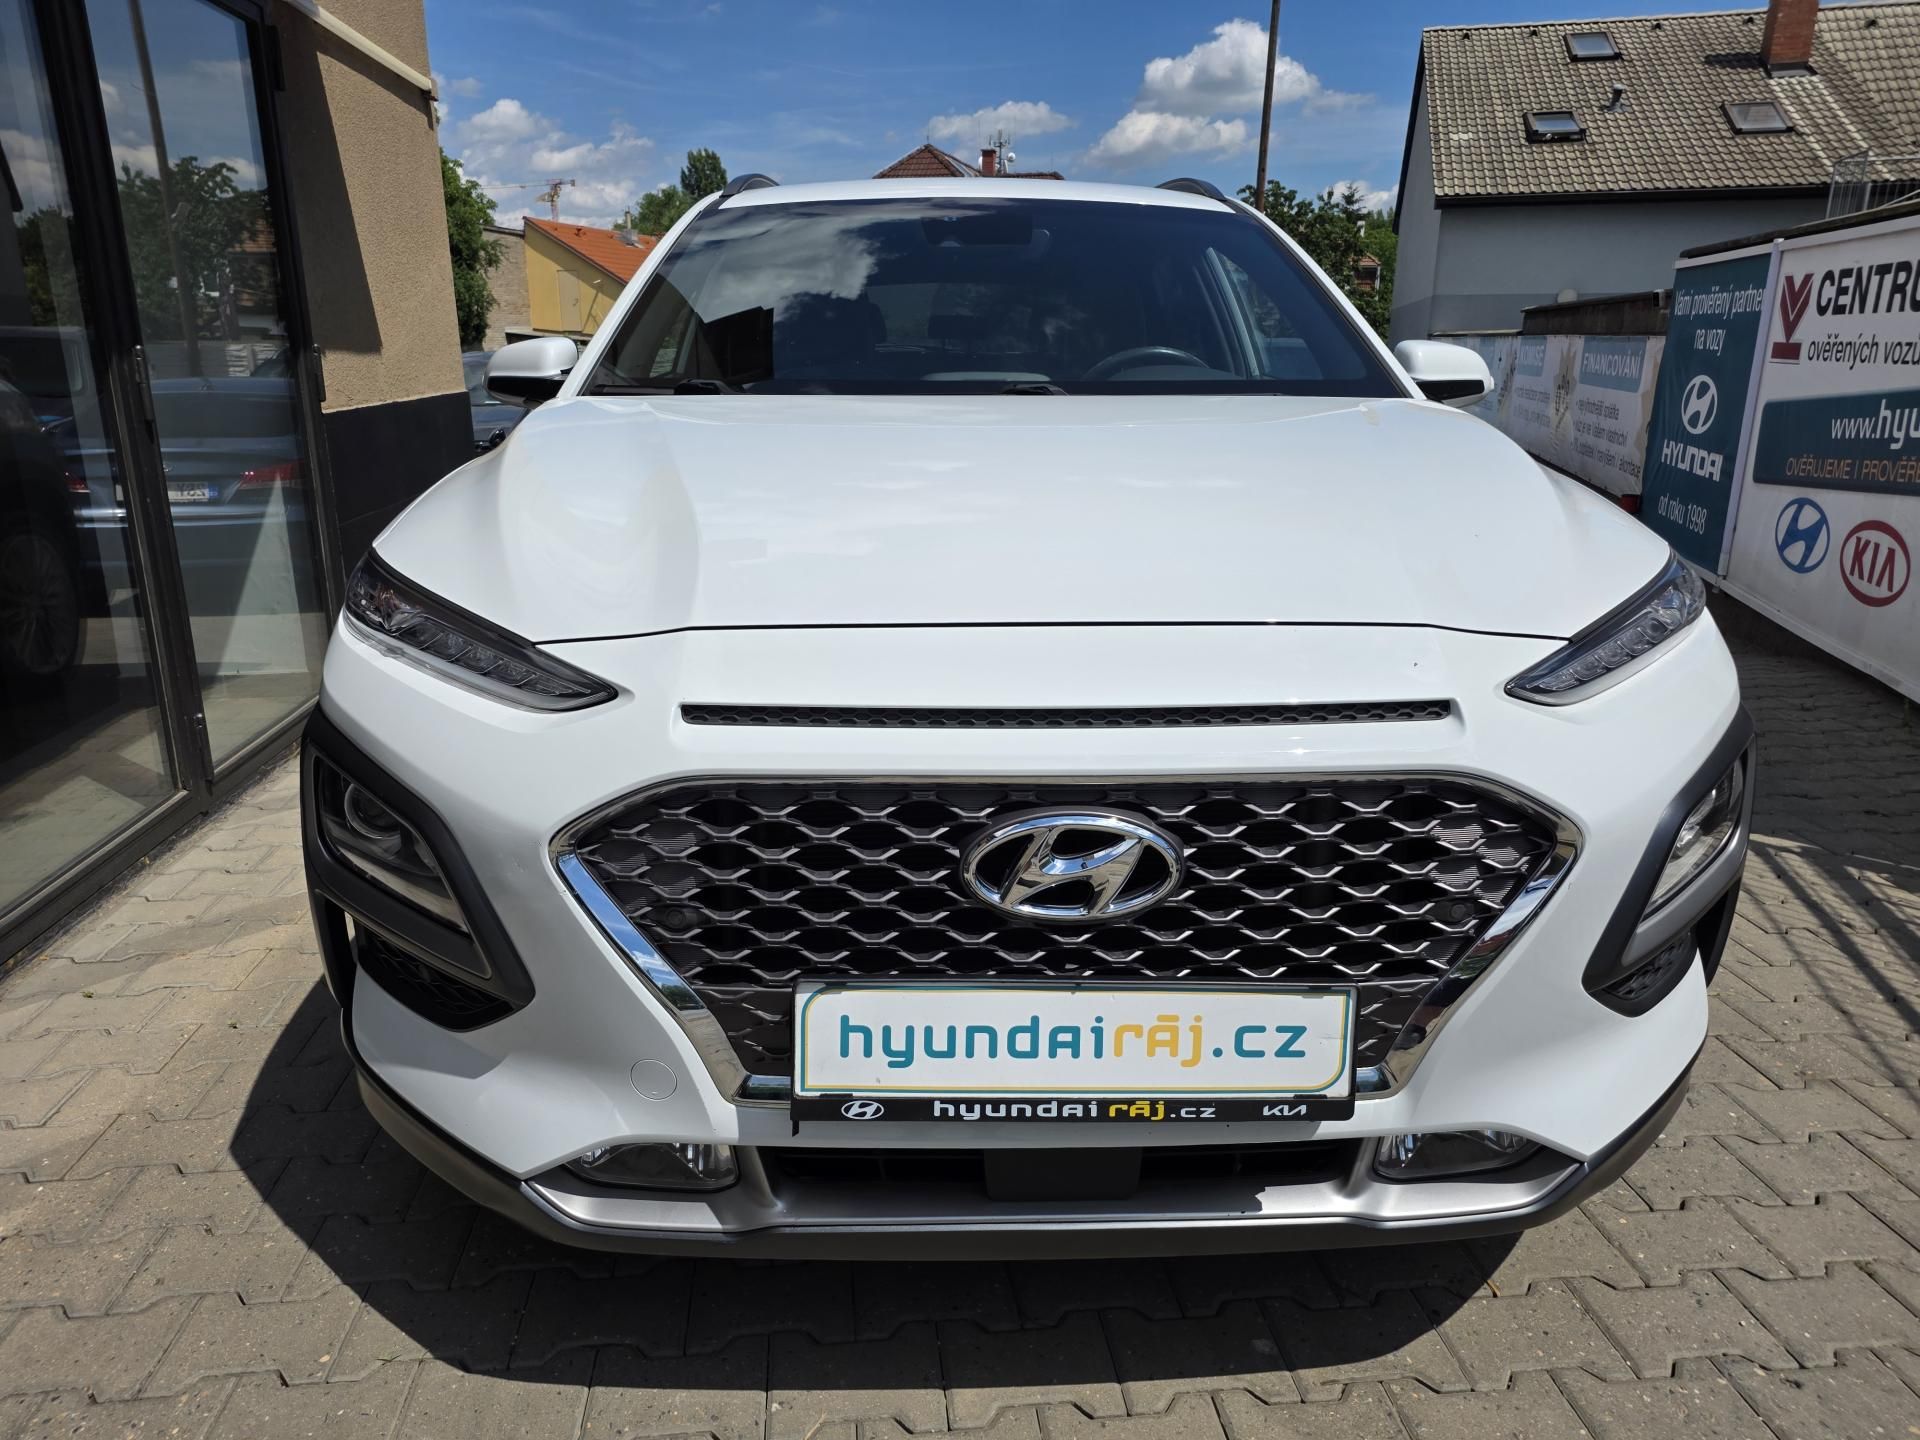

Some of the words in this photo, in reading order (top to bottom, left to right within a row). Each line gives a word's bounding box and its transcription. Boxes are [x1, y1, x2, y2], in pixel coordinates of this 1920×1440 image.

[1691, 284, 1733, 320] prověřený
[1694, 328, 1706, 350] na
[1706, 328, 1726, 356] vozy
[1807, 332, 1879, 371] ověřených
[1582, 350, 1642, 380] FINANCOVÁNÍ
[1661, 438, 1723, 482] HYUNDAI
[1786, 453, 1852, 480] OVĚŘUJEME
[1658, 492, 1670, 516] od
[1668, 497, 1685, 525] roku
[1686, 503, 1707, 535] 1998
[1849, 535, 1896, 593] KIA
